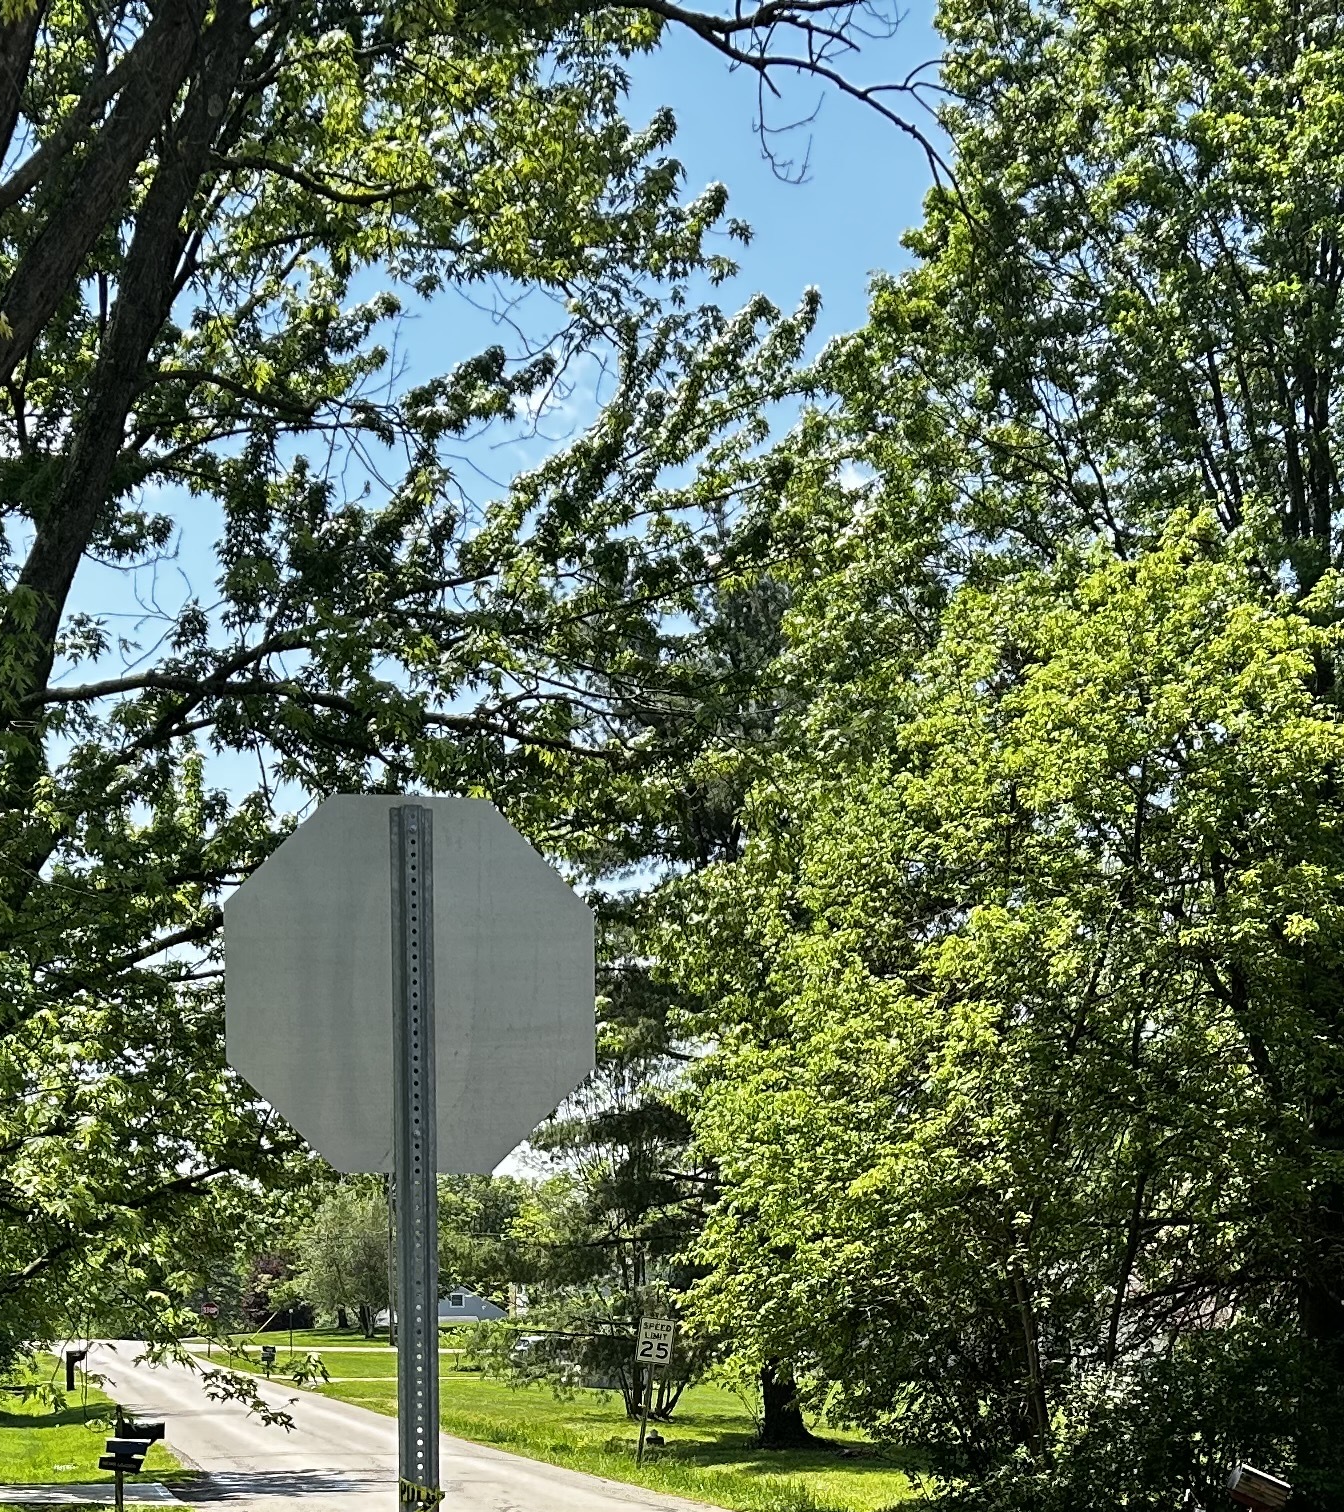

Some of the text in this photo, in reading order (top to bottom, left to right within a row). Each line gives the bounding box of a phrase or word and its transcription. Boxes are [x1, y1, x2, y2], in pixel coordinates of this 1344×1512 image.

[643, 1321, 672, 1332] SPEED
[644, 1332, 668, 1340] LIMIT
[640, 1340, 669, 1360] 25
